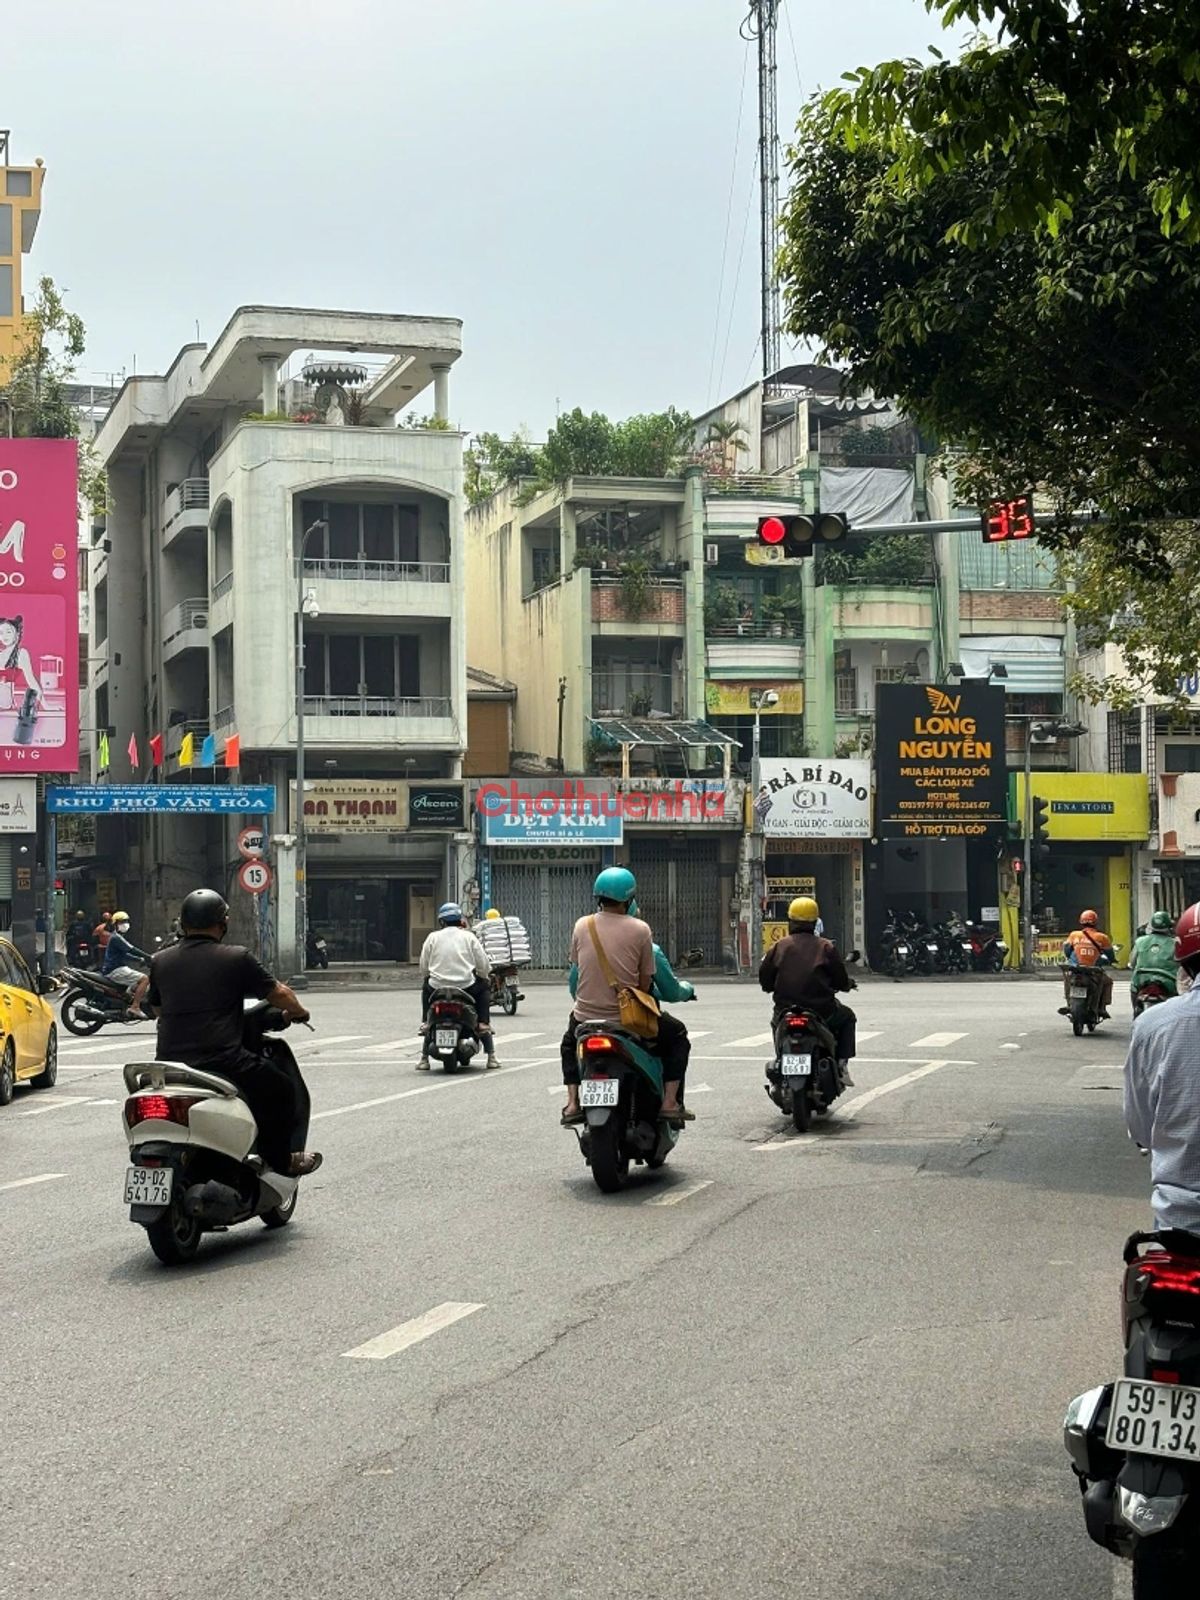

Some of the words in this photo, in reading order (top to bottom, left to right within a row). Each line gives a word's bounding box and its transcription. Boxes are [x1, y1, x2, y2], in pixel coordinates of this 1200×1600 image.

[988, 499, 1031, 539] 35
[914, 717, 976, 735] LONG
[900, 767, 922, 776] MUA
[923, 765, 943, 776] BÁN
[944, 767, 972, 776] TRAO
[802, 764, 822, 782] BÍ
[828, 770, 867, 801] ĐAO
[915, 778, 936, 787] CÁC
[938, 779, 960, 790] LOẠI
[962, 779, 974, 787] XE
[55, 798, 104, 807] KHU
[112, 794, 158, 807] PHỐ
[166, 796, 212, 807] VĂN
[219, 797, 267, 807] HÓA
[927, 792, 960, 800] HOTLINE
[1081, 803, 1112, 811] STORE
[560, 813, 606, 826] KIM
[249, 869, 262, 883] 15
[1127, 1384, 1197, 1420] 59-V3
[1116, 1415, 1197, 1454] 801.34
